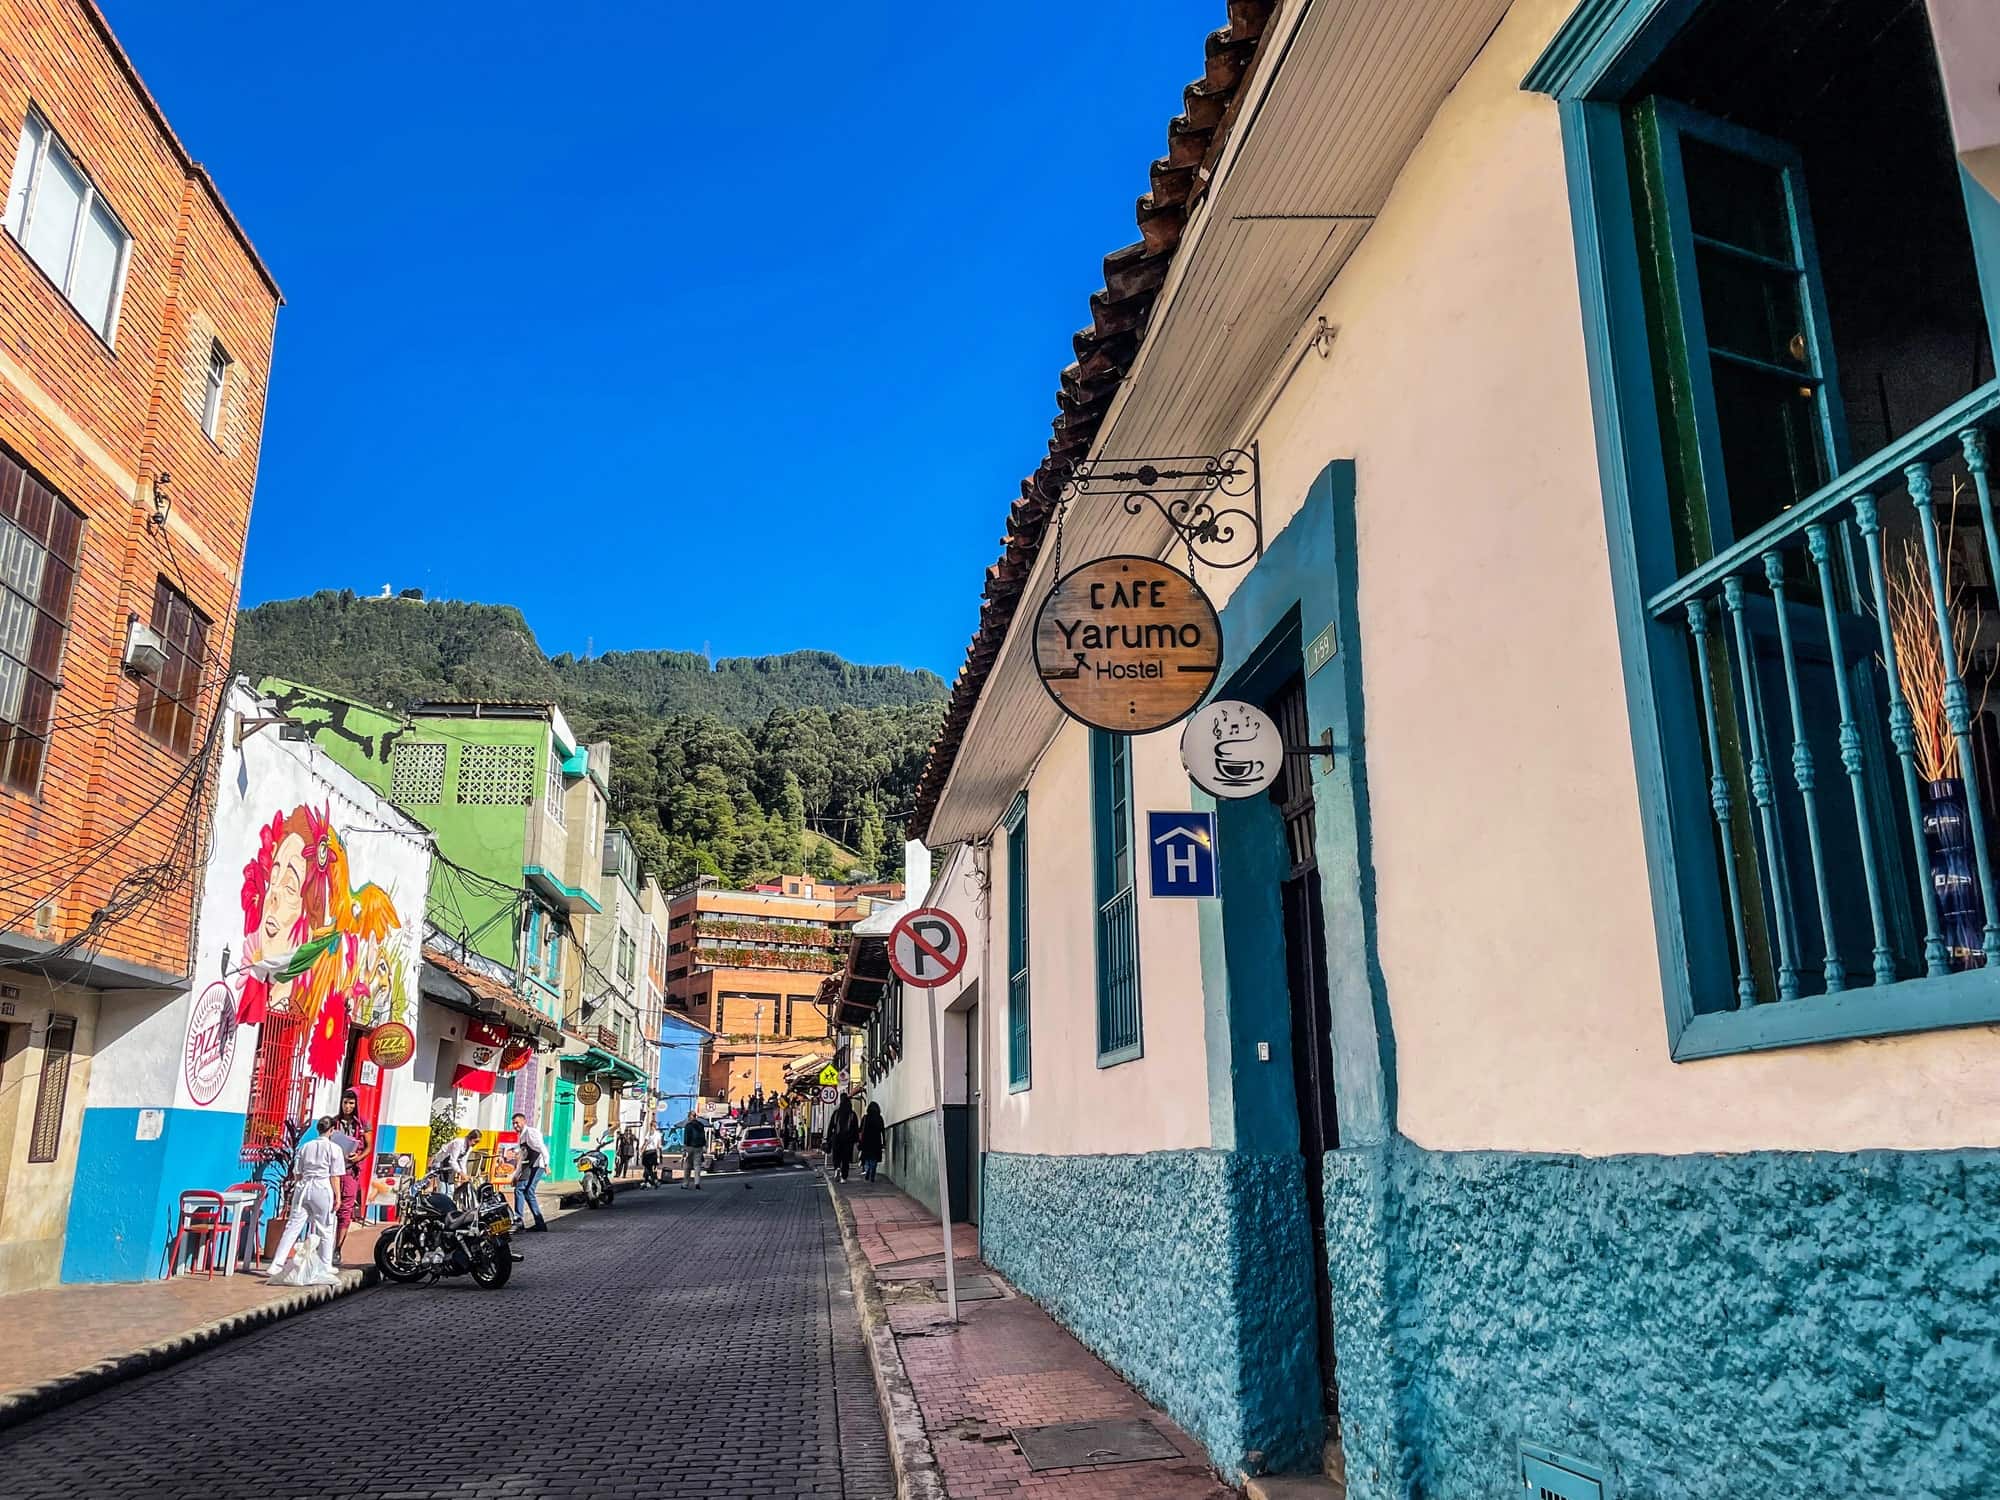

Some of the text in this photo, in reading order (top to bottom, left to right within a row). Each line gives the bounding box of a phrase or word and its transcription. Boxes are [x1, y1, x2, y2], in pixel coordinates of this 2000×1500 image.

[1090, 580, 1167, 609] CAFE
[1055, 619, 1201, 650] Yarumo
[1096, 660, 1163, 680] Hostel
[1166, 844, 1198, 883] H
[913, 920, 951, 975] P
[373, 1036, 406, 1050] PIZZA
[823, 1089, 835, 1100] 30
